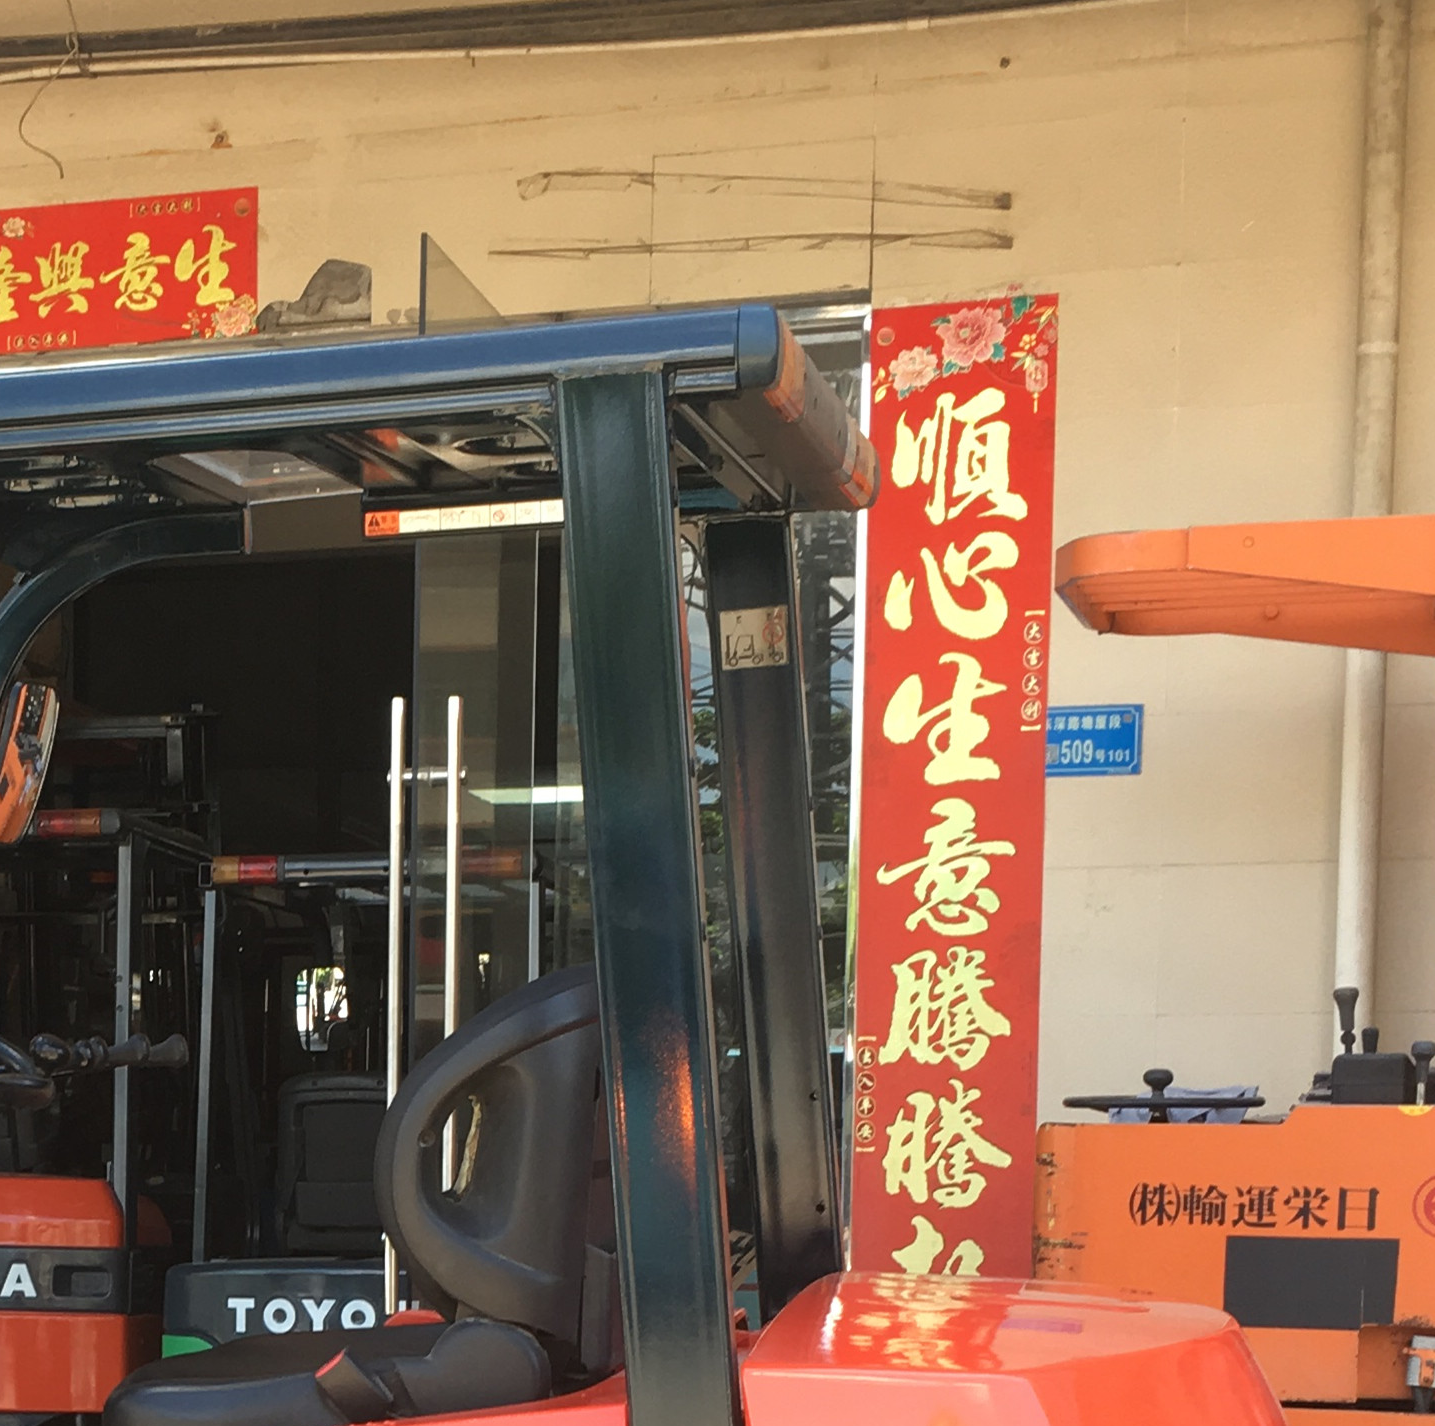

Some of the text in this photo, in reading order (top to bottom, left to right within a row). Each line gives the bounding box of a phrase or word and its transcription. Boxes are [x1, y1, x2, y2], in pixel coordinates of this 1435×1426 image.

[1021, 620, 1045, 722] 大吉大利
[856, 1046, 877, 1143] 出入平安
